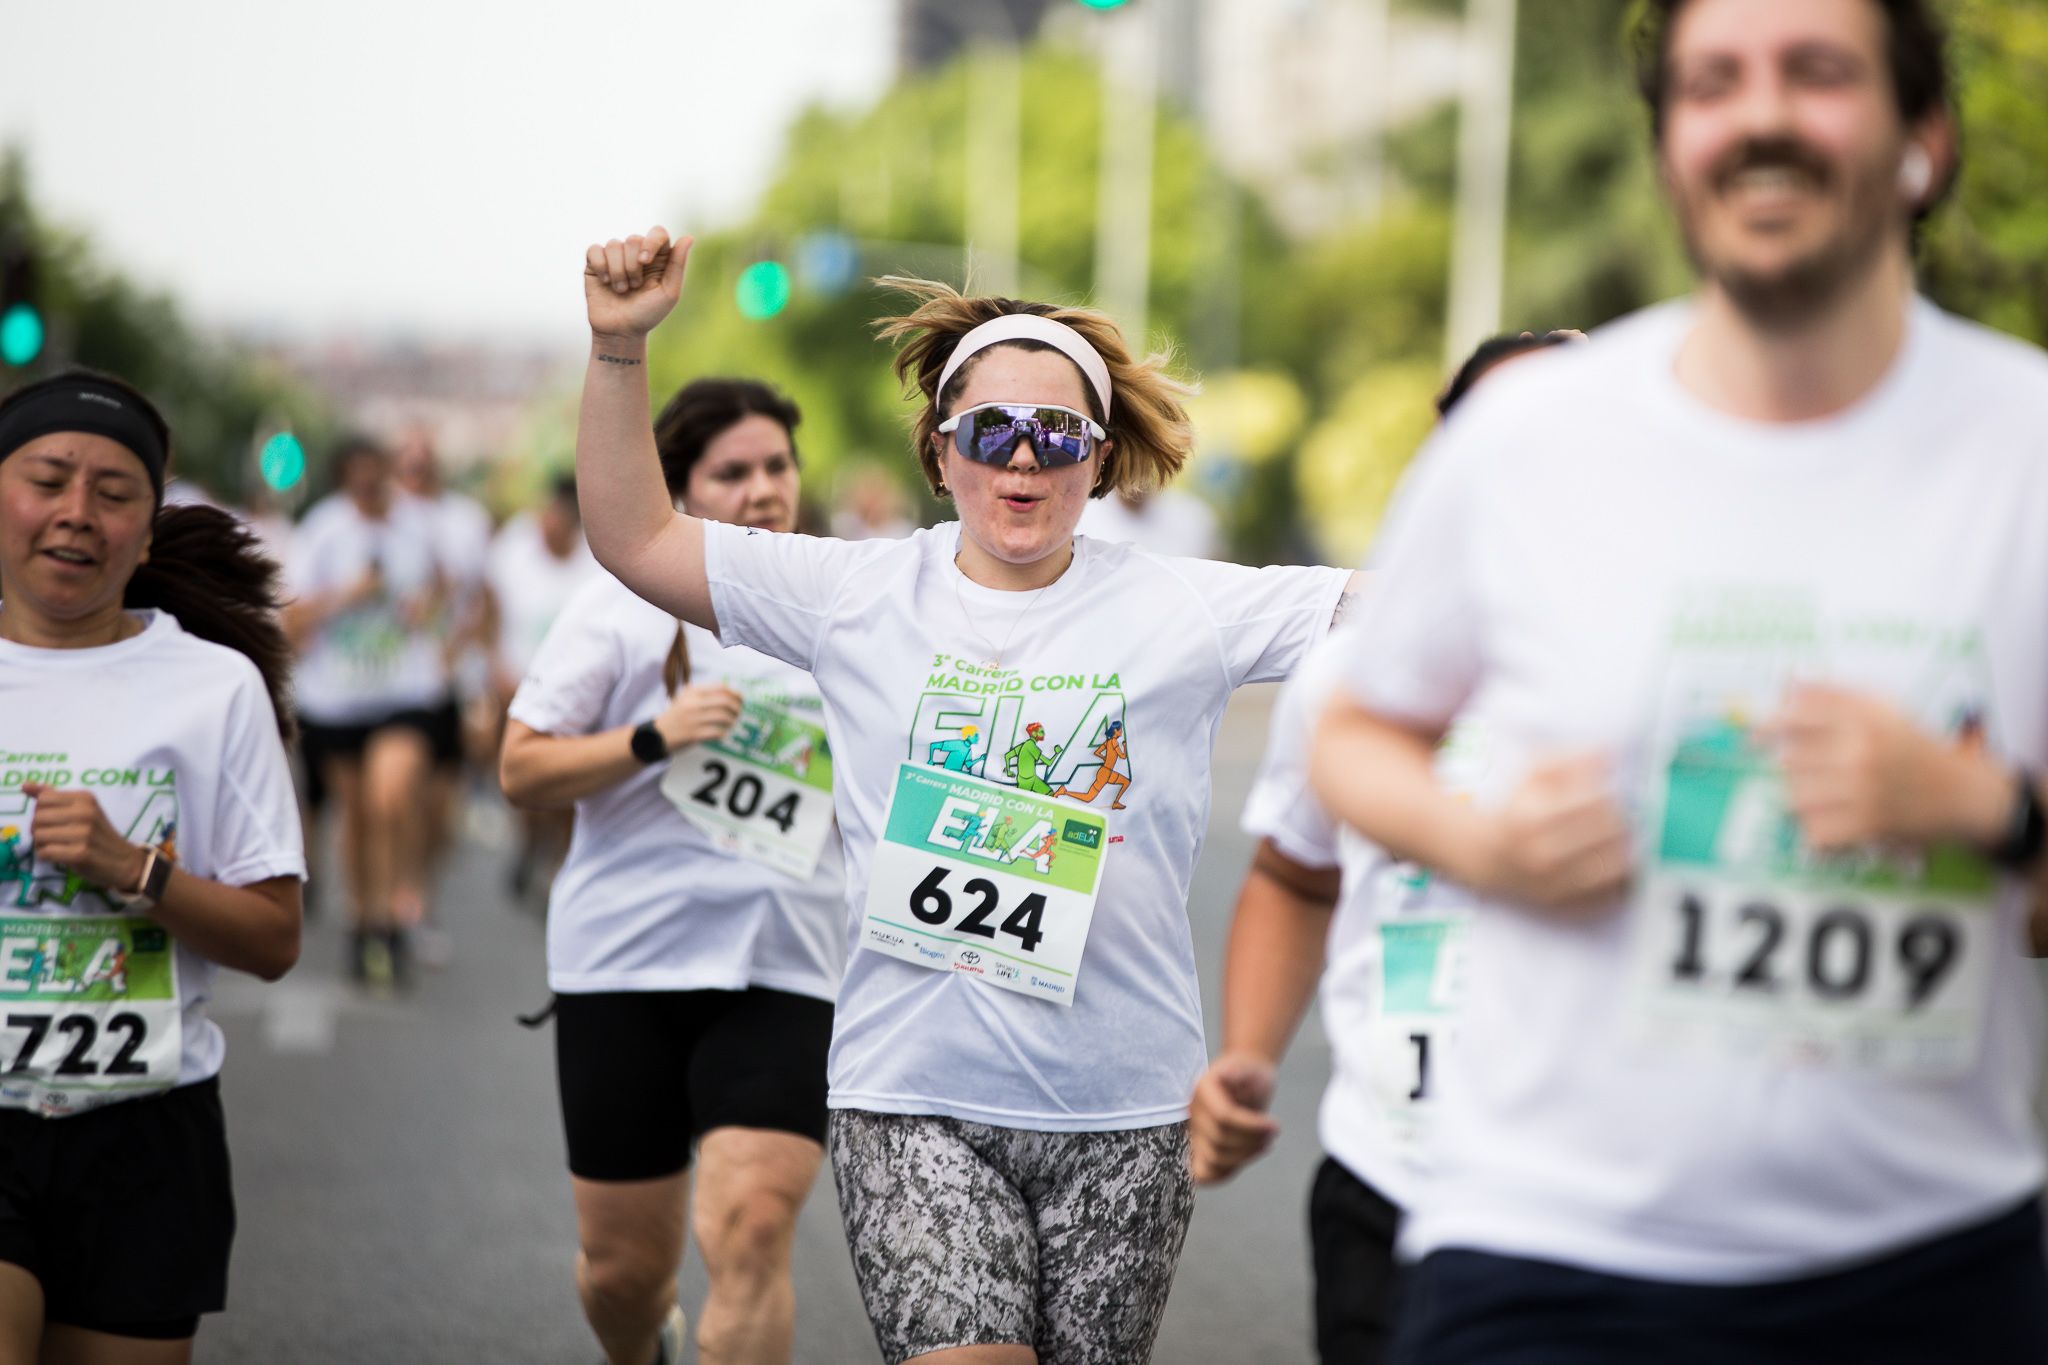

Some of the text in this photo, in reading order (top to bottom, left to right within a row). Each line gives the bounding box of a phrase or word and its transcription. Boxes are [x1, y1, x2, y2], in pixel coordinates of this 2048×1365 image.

[926, 672, 1121, 695] MADRID CON LA
[0, 768, 176, 786] DRID CON LA
[690, 758, 803, 834] 204
[949, 783, 1004, 806] MADRID
[1006, 799, 1035, 814] CON
[1036, 807, 1054, 819] LA
[926, 795, 1056, 875] ELA
[909, 866, 1047, 953] 624
[0, 937, 128, 992] ELA
[1672, 893, 1964, 1015] 1209
[0, 1012, 149, 1076] 722
